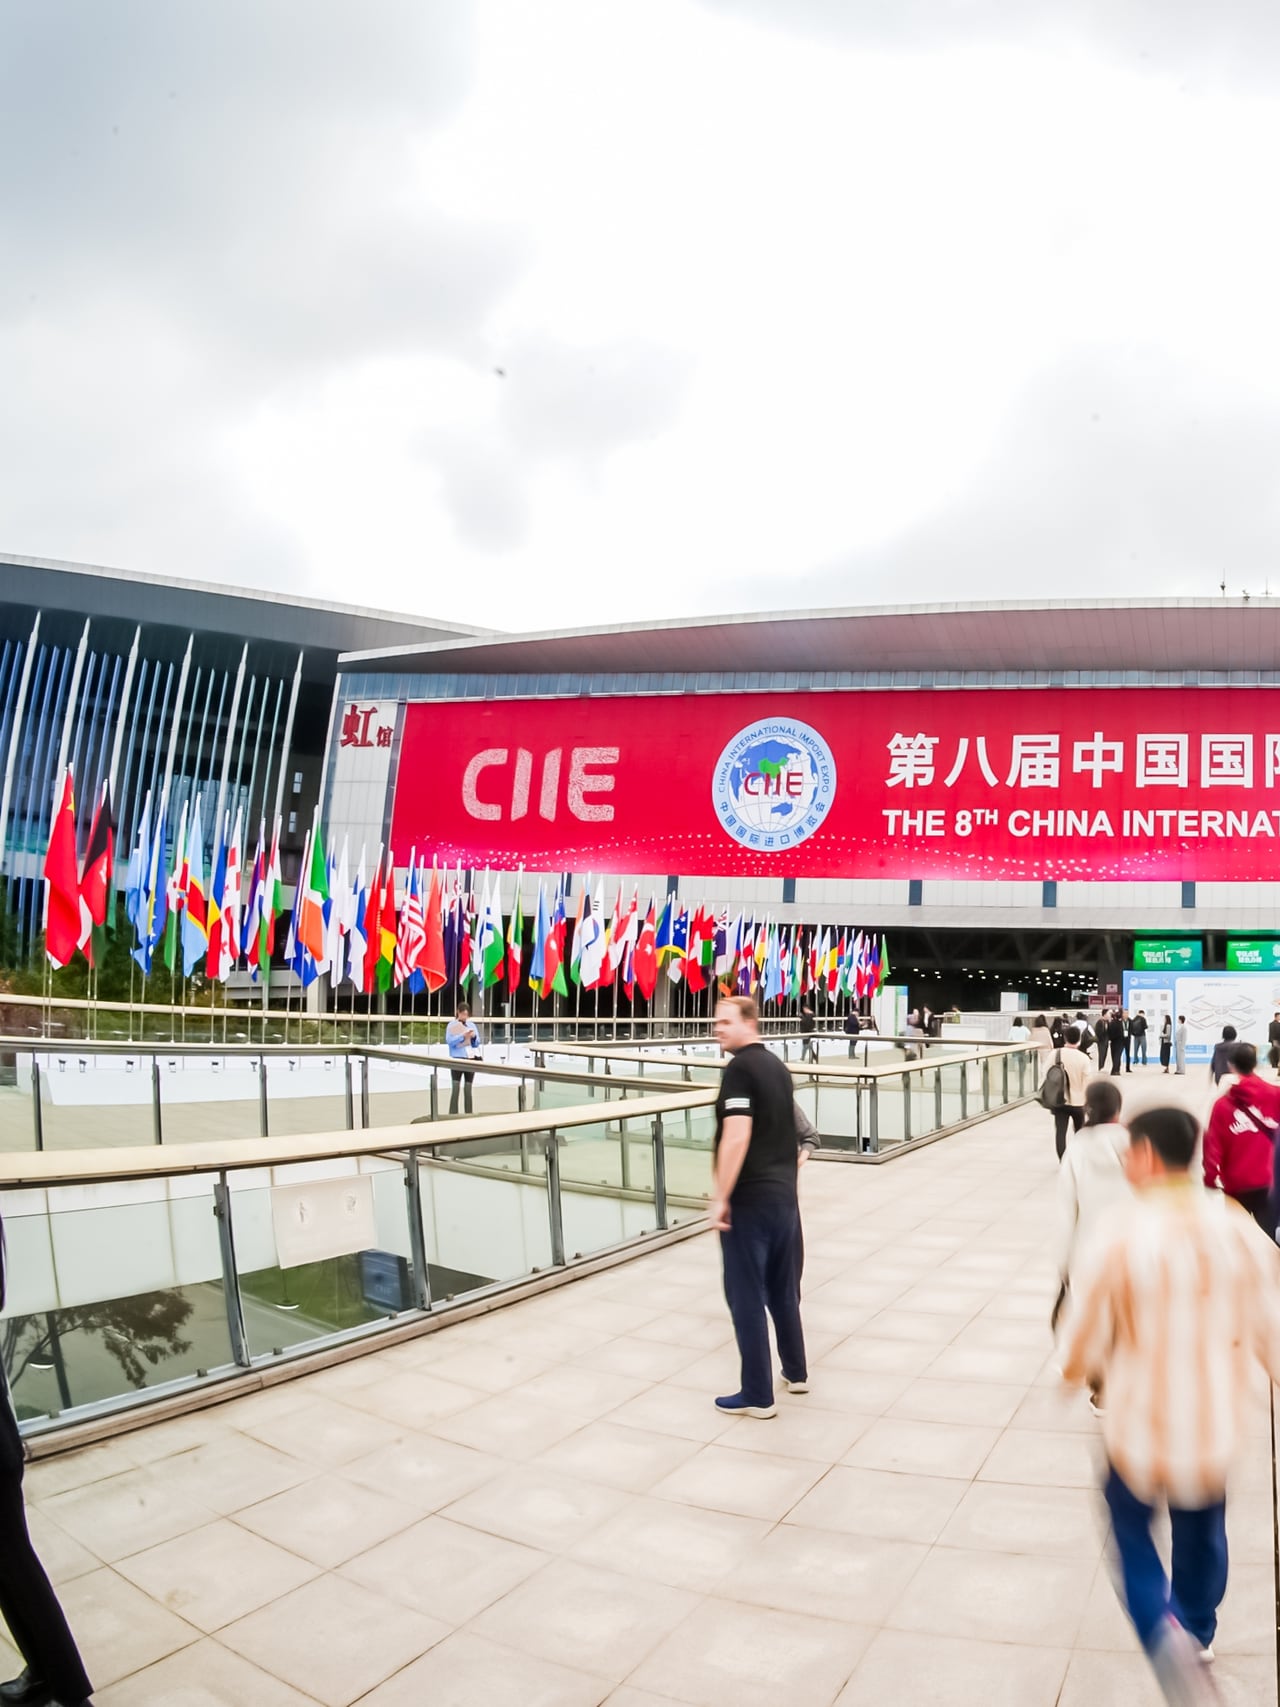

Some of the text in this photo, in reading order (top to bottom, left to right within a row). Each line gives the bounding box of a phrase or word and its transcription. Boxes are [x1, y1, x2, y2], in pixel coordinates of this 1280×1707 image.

[719, 725, 830, 793] CHINA INTERNATIONAL IMPORT EXPO
[462, 747, 620, 822] CIIE
[744, 772, 803, 796] CIIE
[882, 809, 946, 836] THE
[955, 808, 998, 837] 8TH
[1008, 809, 1114, 837] CHINA
